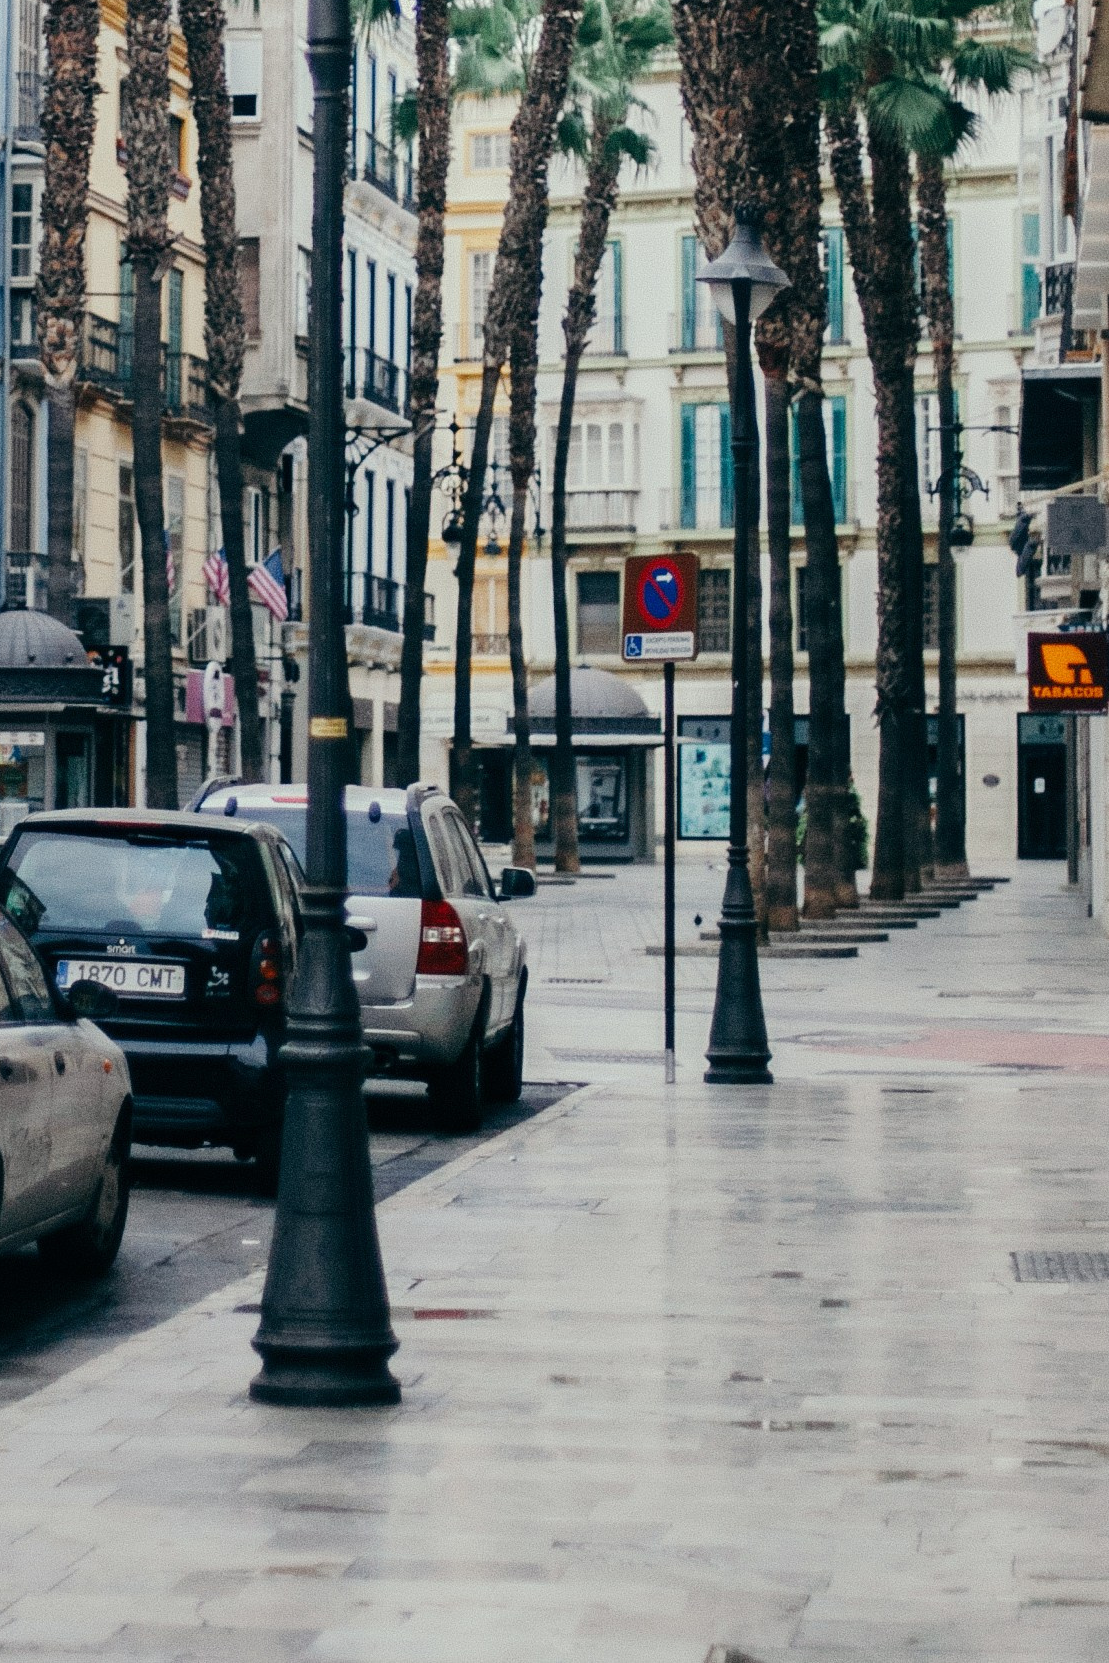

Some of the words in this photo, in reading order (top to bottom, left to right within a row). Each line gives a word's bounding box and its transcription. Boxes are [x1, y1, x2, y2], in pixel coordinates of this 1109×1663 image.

[1032, 685, 1104, 699] TABACOS
[106, 944, 137, 954] smart
[78, 964, 127, 986] 1870
[136, 967, 176, 989] CMT
